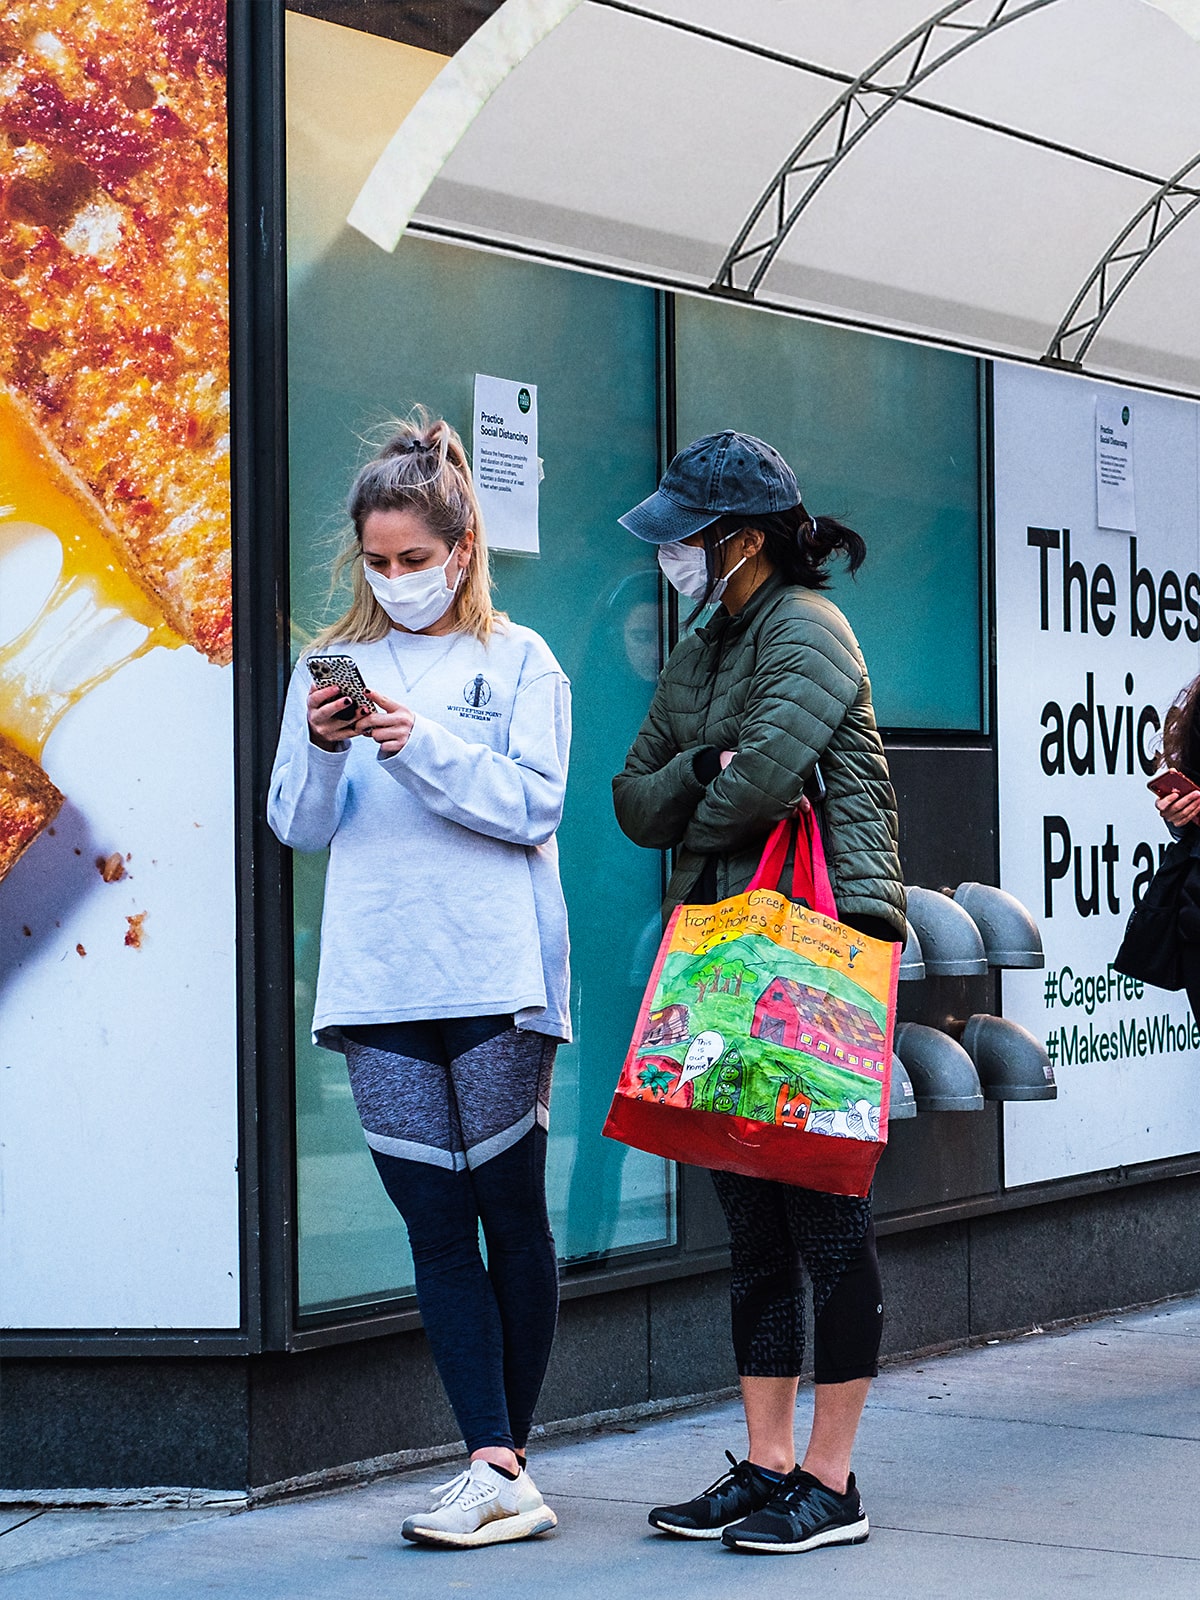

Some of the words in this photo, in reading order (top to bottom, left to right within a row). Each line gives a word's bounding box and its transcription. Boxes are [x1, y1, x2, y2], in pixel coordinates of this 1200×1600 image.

[480, 425, 498, 437] Social
[499, 428, 528, 445] Distancing
[481, 411, 504, 425] Practice
[1027, 526, 1117, 637] The
[459, 712, 491, 721] MICHIGAN
[1040, 671, 1161, 777] advic
[1043, 815, 1120, 918] Put
[685, 909, 716, 928] From
[720, 907, 734, 916] the
[748, 889, 785, 913] Green
[790, 903, 848, 940] Mountains
[725, 914, 767, 929] homes
[697, 1038, 712, 1046] This
[1046, 1011, 1200, 1068] #MakesMeWhole
